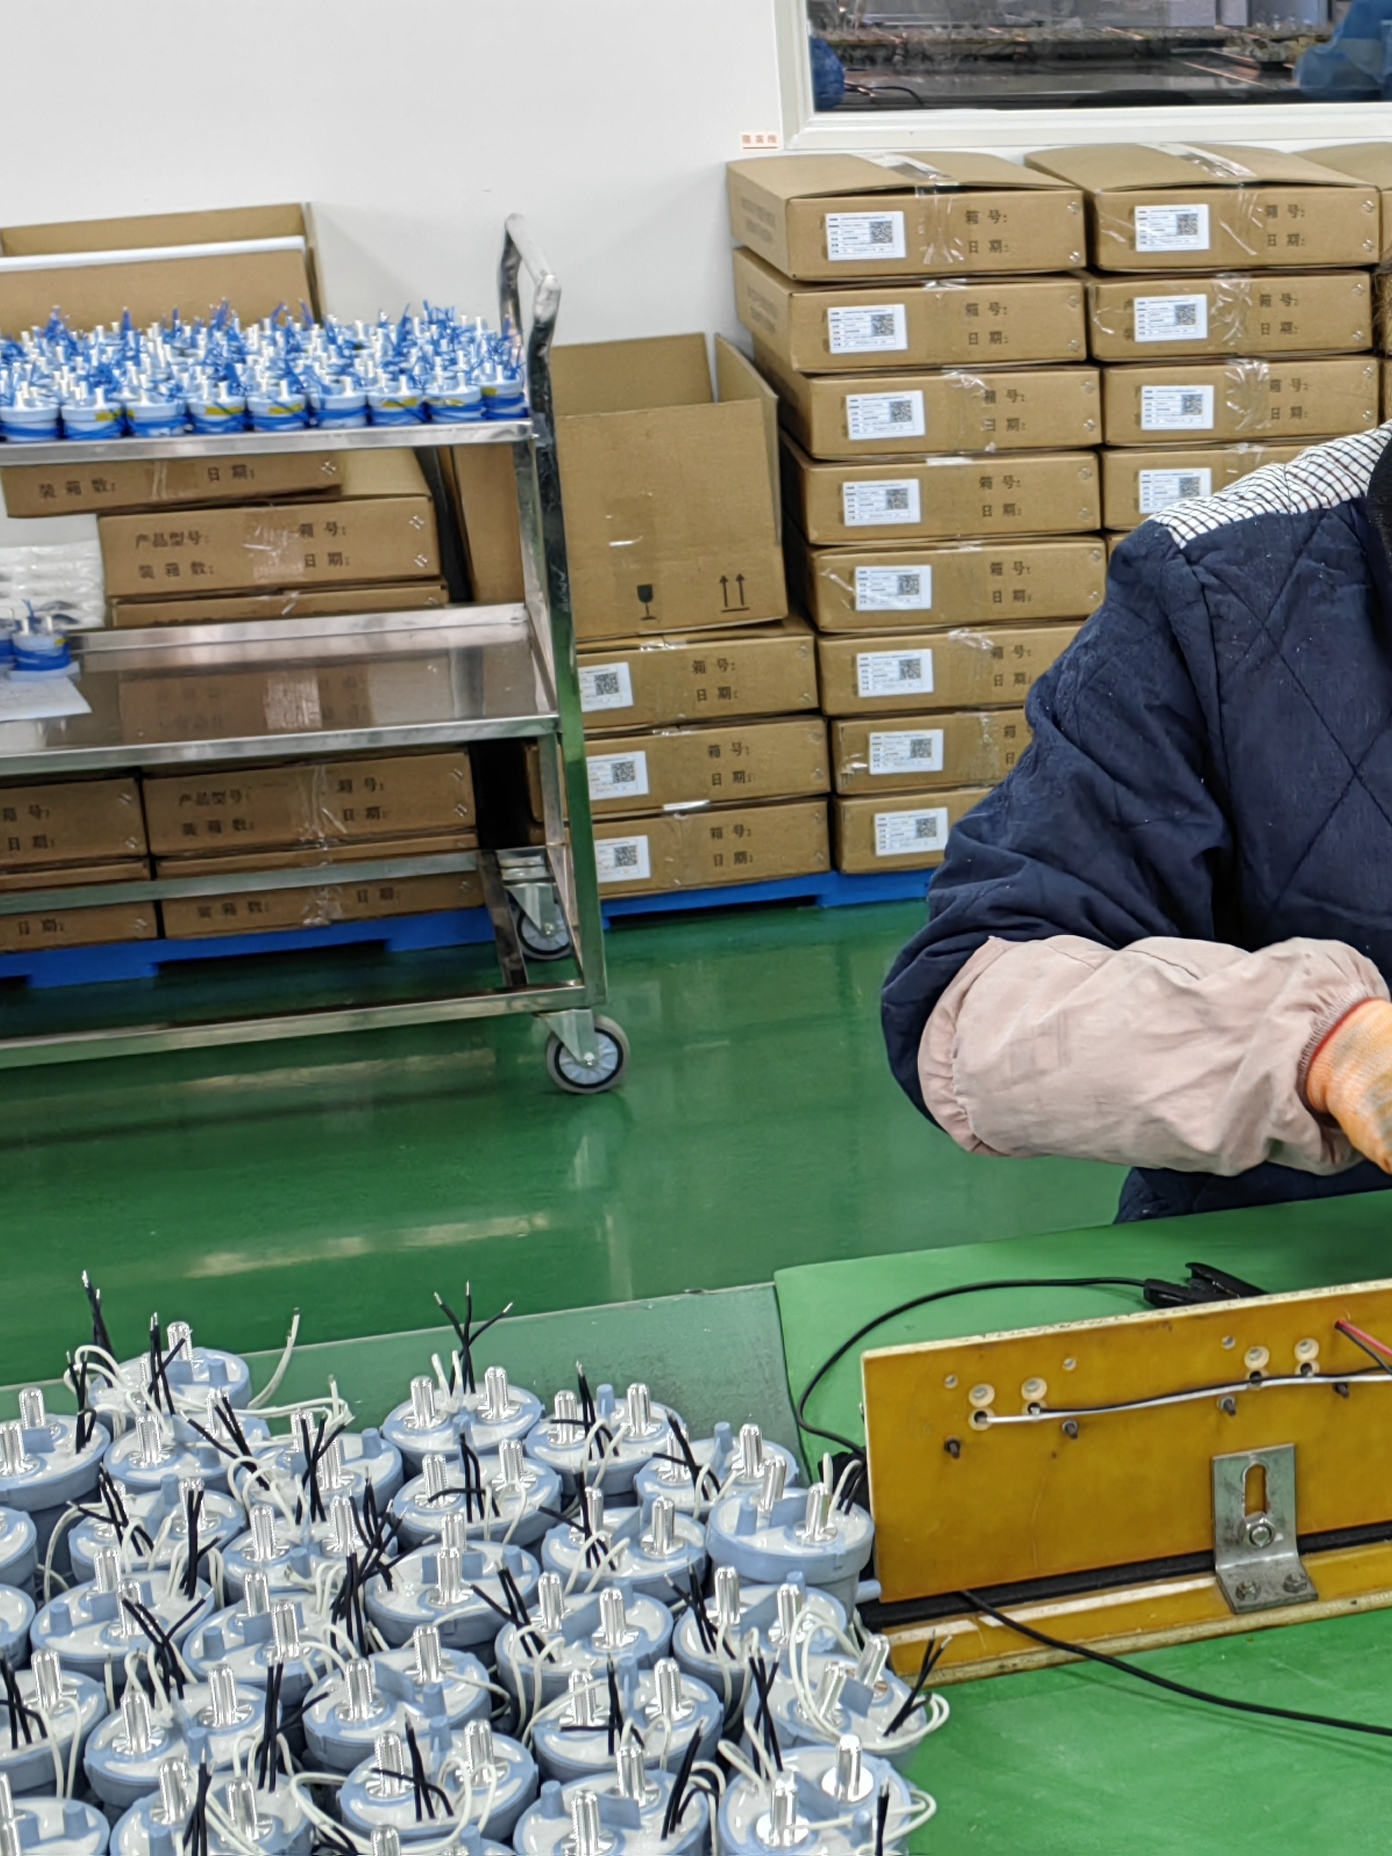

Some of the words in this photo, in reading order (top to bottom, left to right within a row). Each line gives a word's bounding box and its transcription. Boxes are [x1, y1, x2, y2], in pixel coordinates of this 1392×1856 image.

[968, 239, 1009, 254] 日期:
[1261, 322, 1299, 336] 日期:
[968, 331, 1009, 346] 日期:
[1271, 406, 1308, 420] 日期:
[207, 464, 256, 482] 日期:
[39, 477, 116, 499] 装箱数:
[982, 503, 1022, 518] 日期:
[135, 530, 211, 549] 产品型号:
[304, 552, 351, 570] 日期:
[138, 561, 214, 580] 装箱数:
[992, 588, 1033, 604] 日期:
[696, 686, 739, 702] 日期:
[712, 770, 753, 786] 日期:
[713, 851, 753, 867] 日期:
